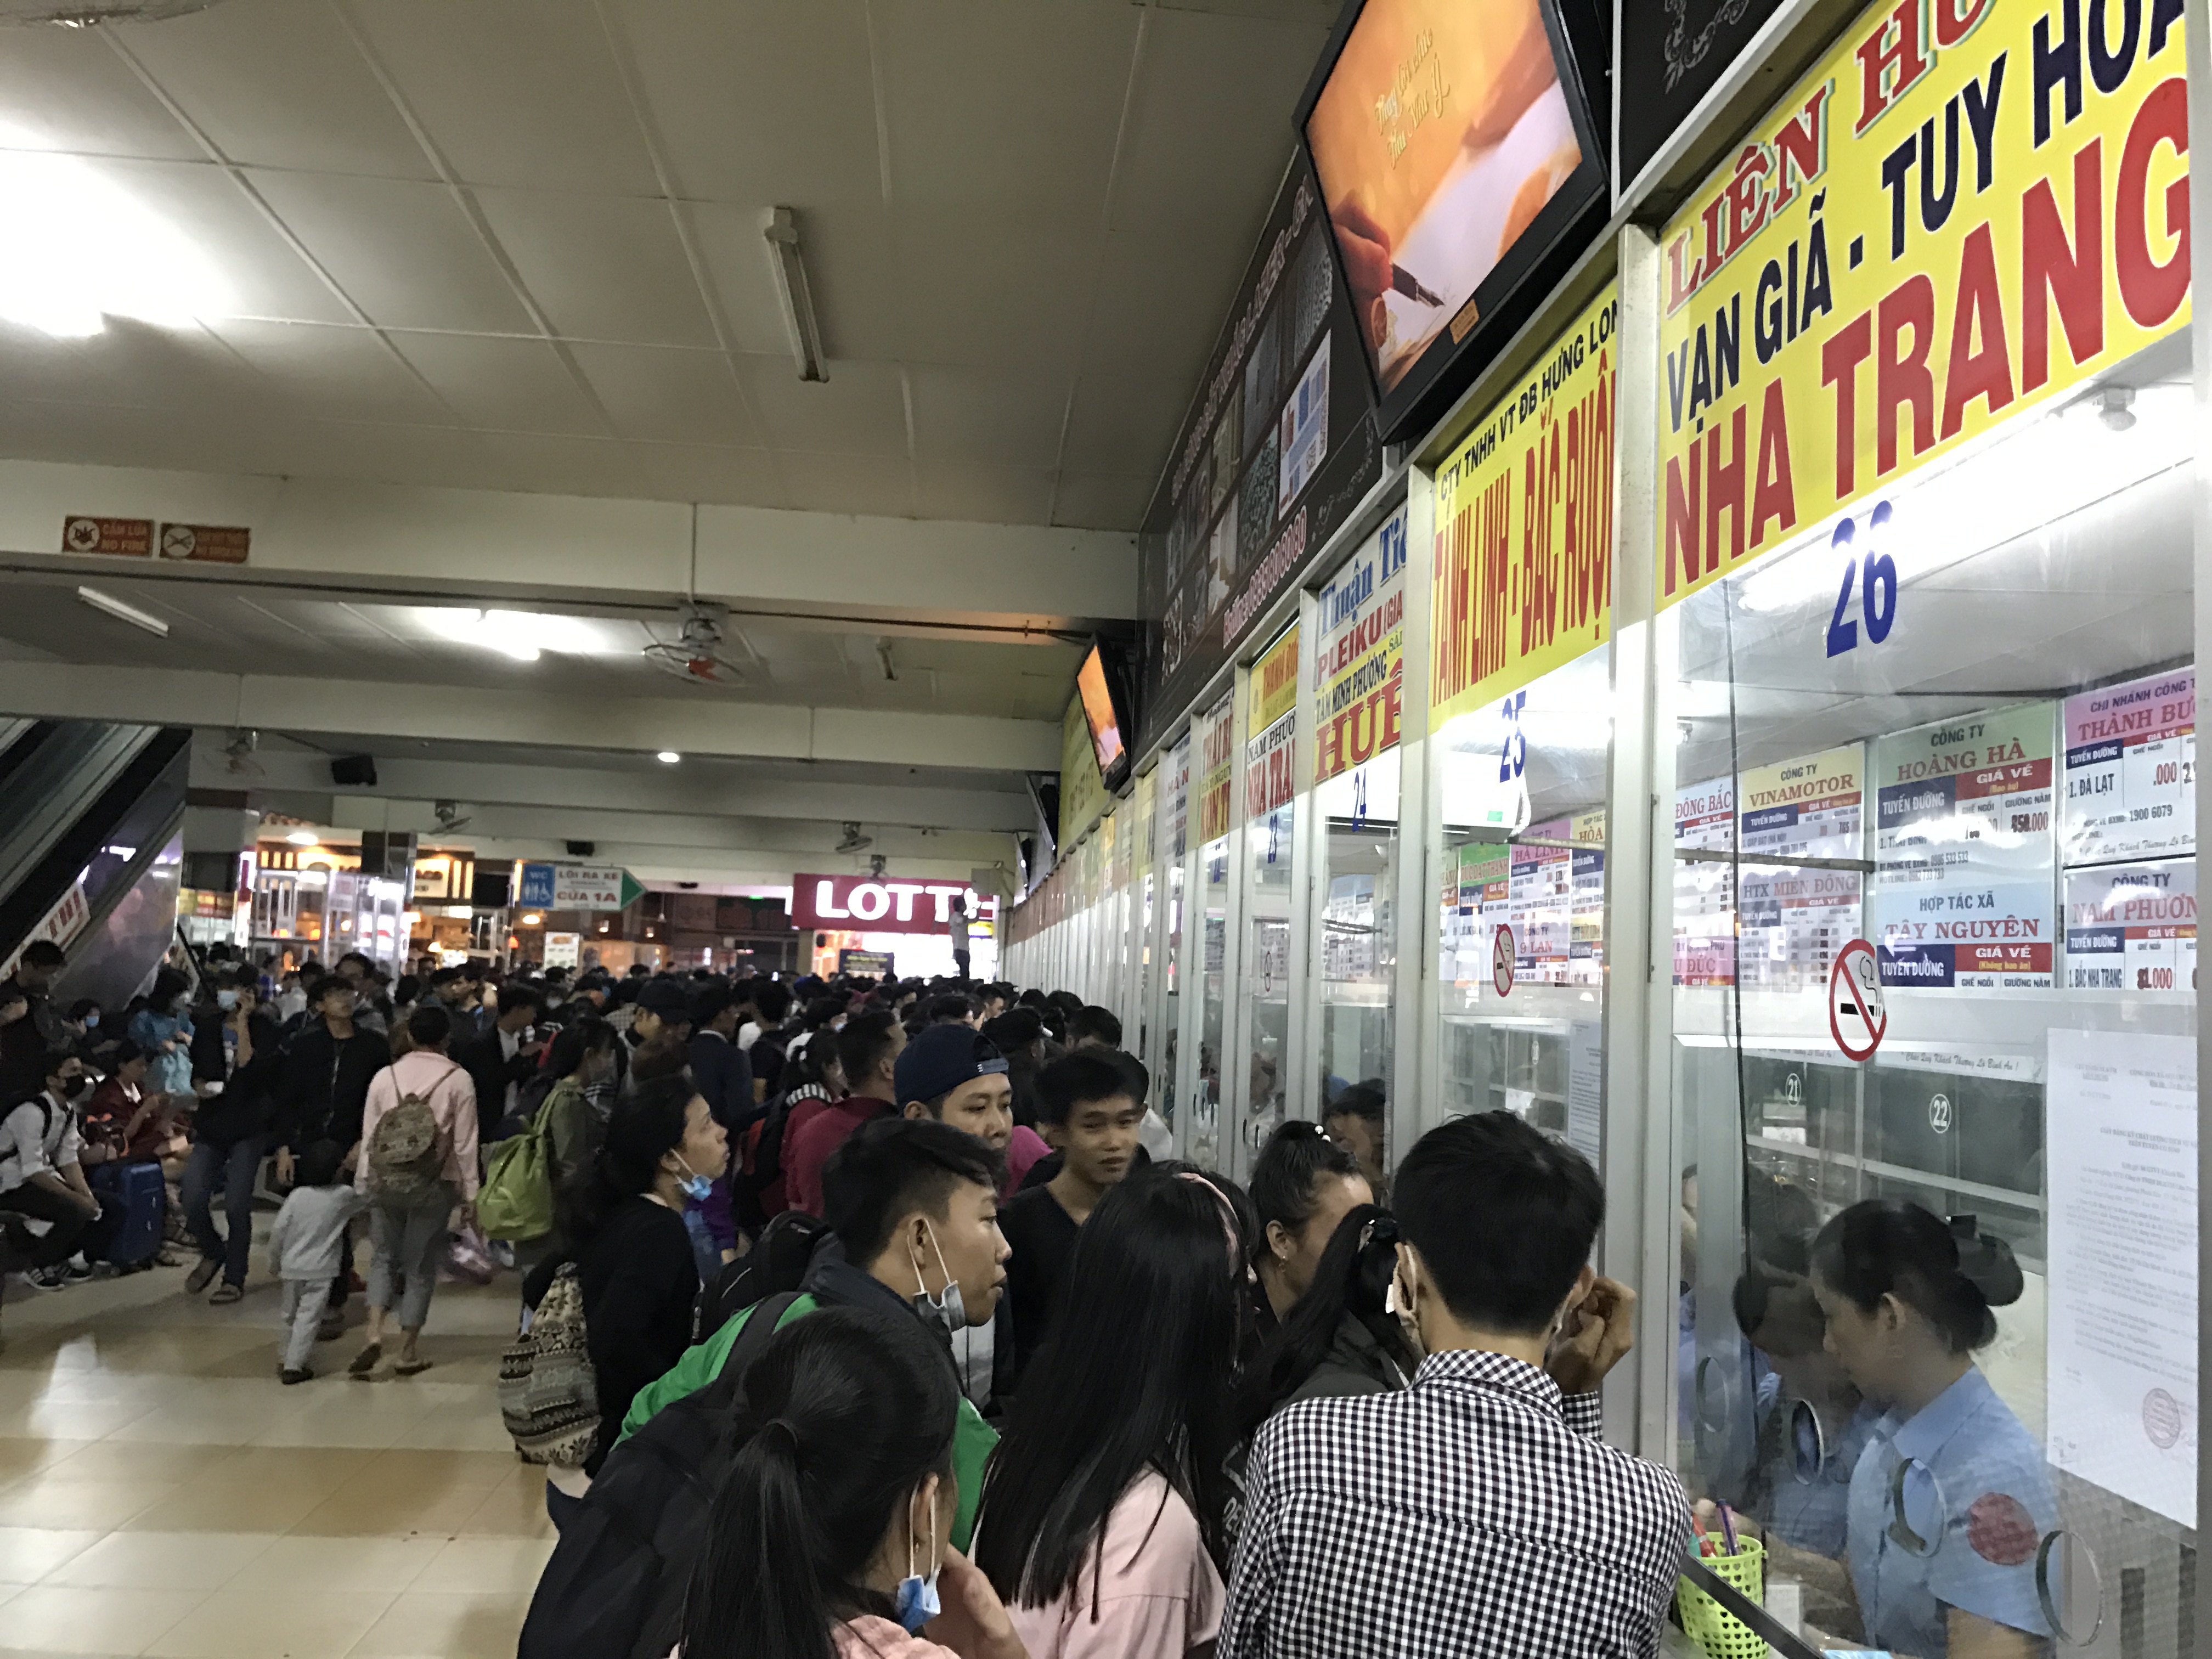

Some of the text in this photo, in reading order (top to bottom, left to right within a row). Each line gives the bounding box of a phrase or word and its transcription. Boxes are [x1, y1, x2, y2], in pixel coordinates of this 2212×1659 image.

[1666, 77, 1835, 318] LIÊN
[1667, 290, 1740, 434] VẠN
[1753, 188, 1832, 365] GIÃ
[1882, 48, 2008, 262] TUY
[1664, 77, 2191, 598] NHA TRANG
[1441, 458, 1462, 501] CTY
[1464, 424, 1496, 478] TNHH
[1500, 403, 1516, 442] VT
[1519, 382, 1537, 424] ĐB
[1542, 334, 1583, 402] HƯNG
[1471, 468, 1510, 685] LINH
[1521, 397, 1559, 657] BẮC
[1827, 500, 1898, 658] 26
[1321, 558, 1373, 640] Thuận
[1318, 606, 1382, 686] PLEIKU
[1333, 675, 1351, 714] MINH
[1352, 650, 1387, 700] PHƯƠNG
[2090, 680, 2186, 712] CHI NHÁNH CÔNG
[2079, 695, 2196, 741] THÀNH BƯ
[1500, 690, 1526, 783] 25
[1931, 724, 1985, 747] CÔNG TY
[1248, 733, 1266, 764] NAM
[1897, 737, 2026, 781] HOÀNG HÀ
[2071, 749, 2091, 764] TUYẾN
[1781, 763, 1818, 781] CÔNG TY
[1977, 765, 2033, 783] GIÁ VÉ
[2095, 774, 2114, 795] LẠT
[1247, 759, 1266, 823] NHA
[1352, 768, 1366, 832] 24
[1675, 783, 1733, 820] ĐÔNG BẮC
[1750, 774, 1854, 807] VINAMOTOR
[1883, 792, 1944, 815] TUYẾN ĐƯỜNG
[2130, 804, 2172, 821] 1900 6079
[1744, 883, 1769, 898] HTX
[2153, 873, 2171, 887] TY
[594, 893, 616, 902] 1A
[1920, 890, 1994, 913] HỢP TÁC XÃ
[2073, 901, 2116, 923] NAM
[1885, 915, 2040, 940] TÂY NGUYÊN
[1531, 941, 1553, 953] LAN
[1976, 945, 2032, 958] GIÁ VÉ
[2071, 933, 2091, 948] TUYẾN
[1882, 952, 1944, 977] TUYẾN ĐƯỜNG
[1962, 977, 1976, 987] GHẾ
[2088, 969, 2099, 988] NHA
[2101, 968, 2121, 988] TRANG
[1788, 1079, 1797, 1101] 21
[1933, 1099, 1947, 1127] 22
